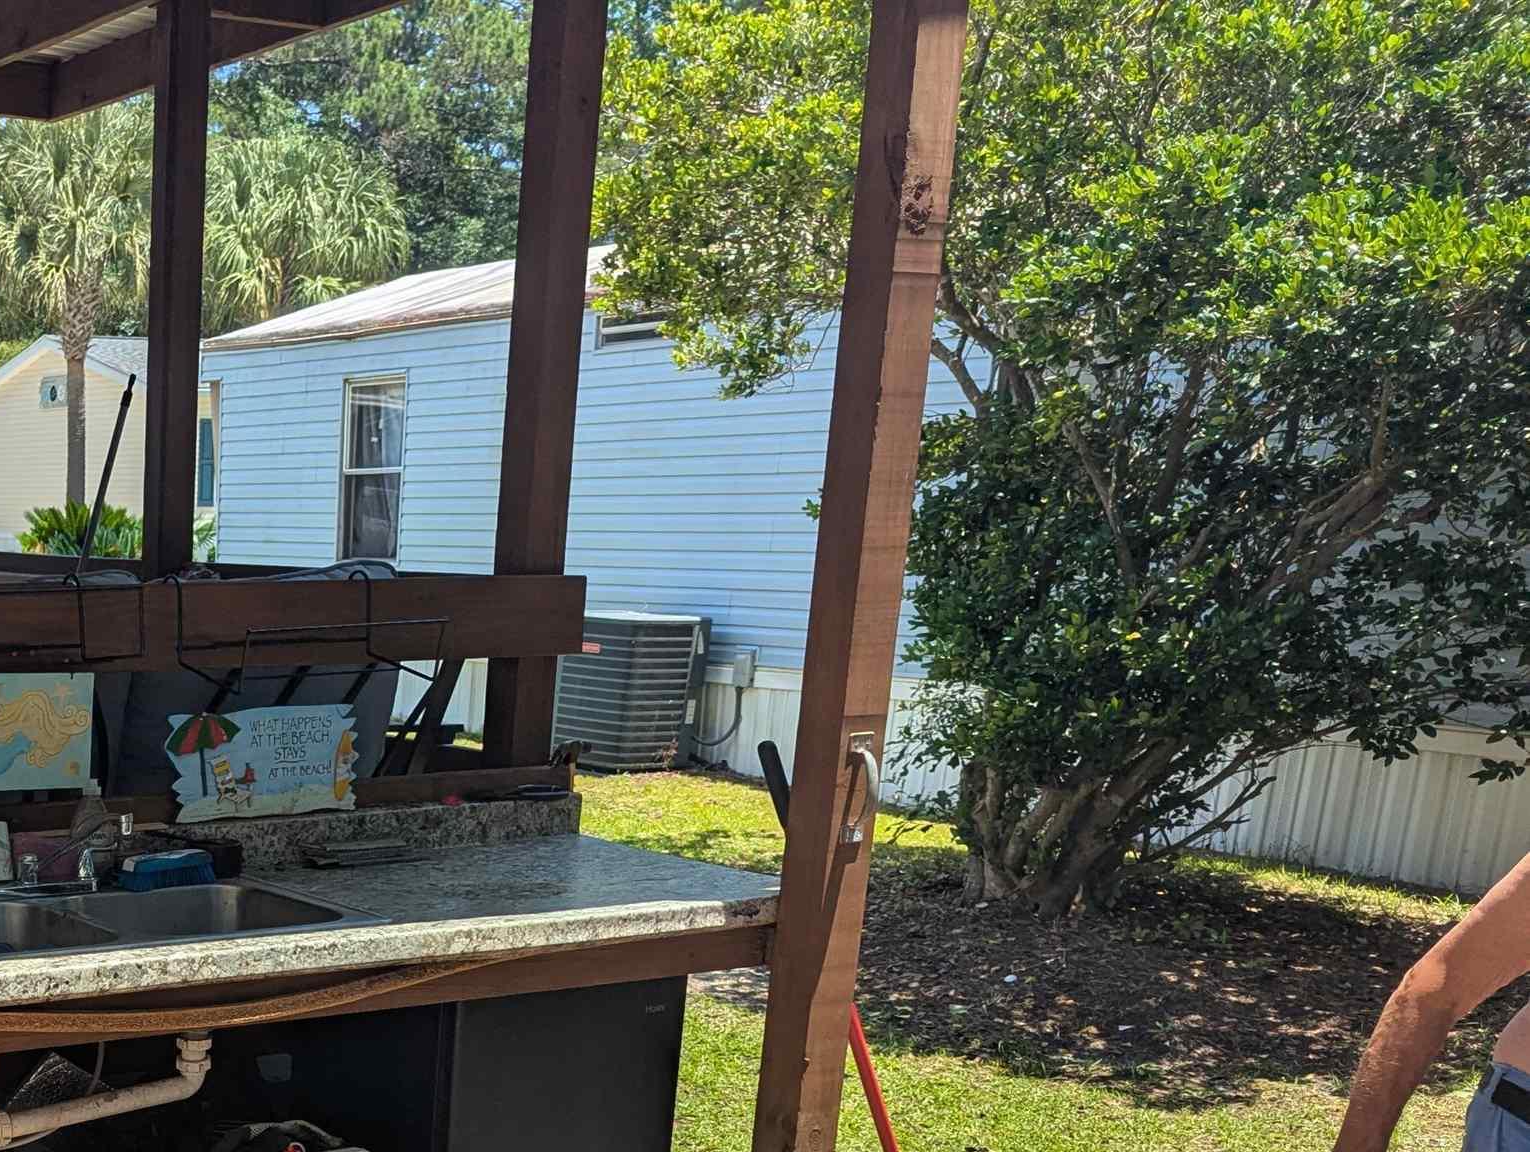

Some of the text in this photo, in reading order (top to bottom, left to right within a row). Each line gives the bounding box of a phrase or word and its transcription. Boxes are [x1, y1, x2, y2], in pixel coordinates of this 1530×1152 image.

[249, 715, 332, 732] WHAT HAPPENS
[251, 734, 263, 747] AT
[268, 731, 289, 745] THE
[274, 745, 306, 760] STAYS
[269, 767, 279, 778] AT
[281, 766, 297, 777] THE
